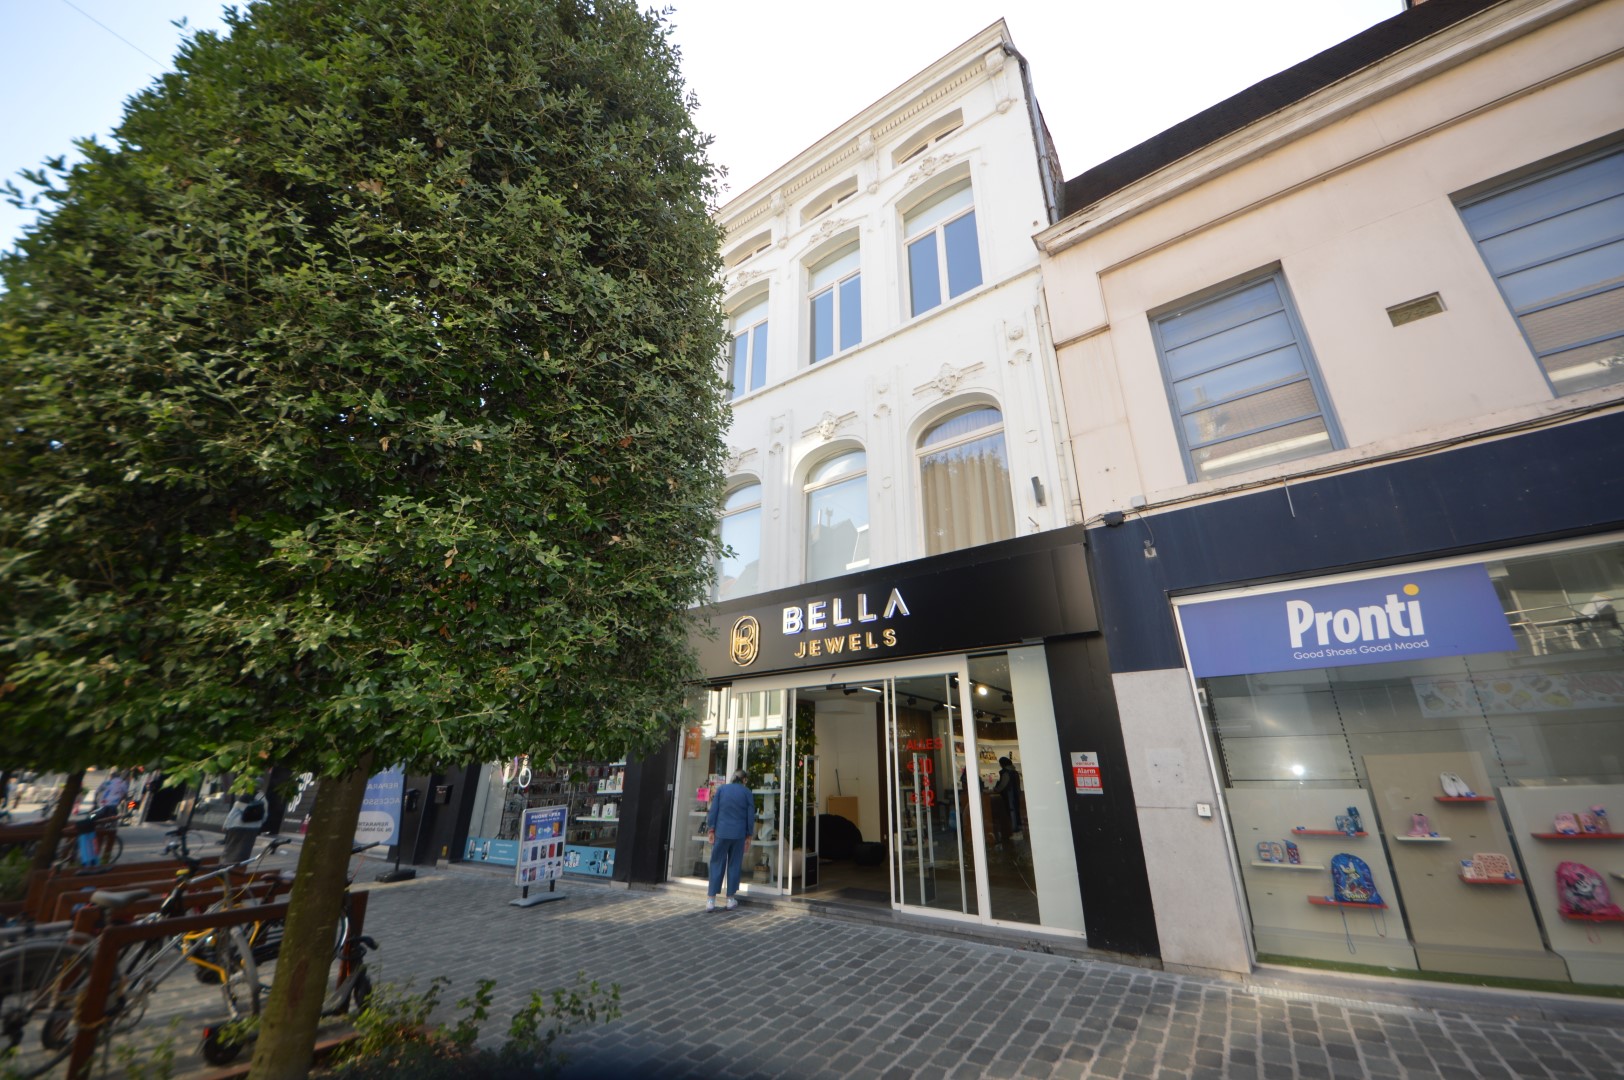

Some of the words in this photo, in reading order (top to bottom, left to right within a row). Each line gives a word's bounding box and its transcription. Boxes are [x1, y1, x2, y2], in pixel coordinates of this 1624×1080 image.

[783, 587, 910, 635] BELLA
[1286, 583, 1425, 648] Pronti
[794, 628, 898, 659] JEWELS
[1293, 651, 1325, 660] Good
[1326, 647, 1357, 657] Shoes
[1359, 643, 1392, 654] Good
[1394, 639, 1430, 651] Mood
[906, 737, 944, 751] ALLES
